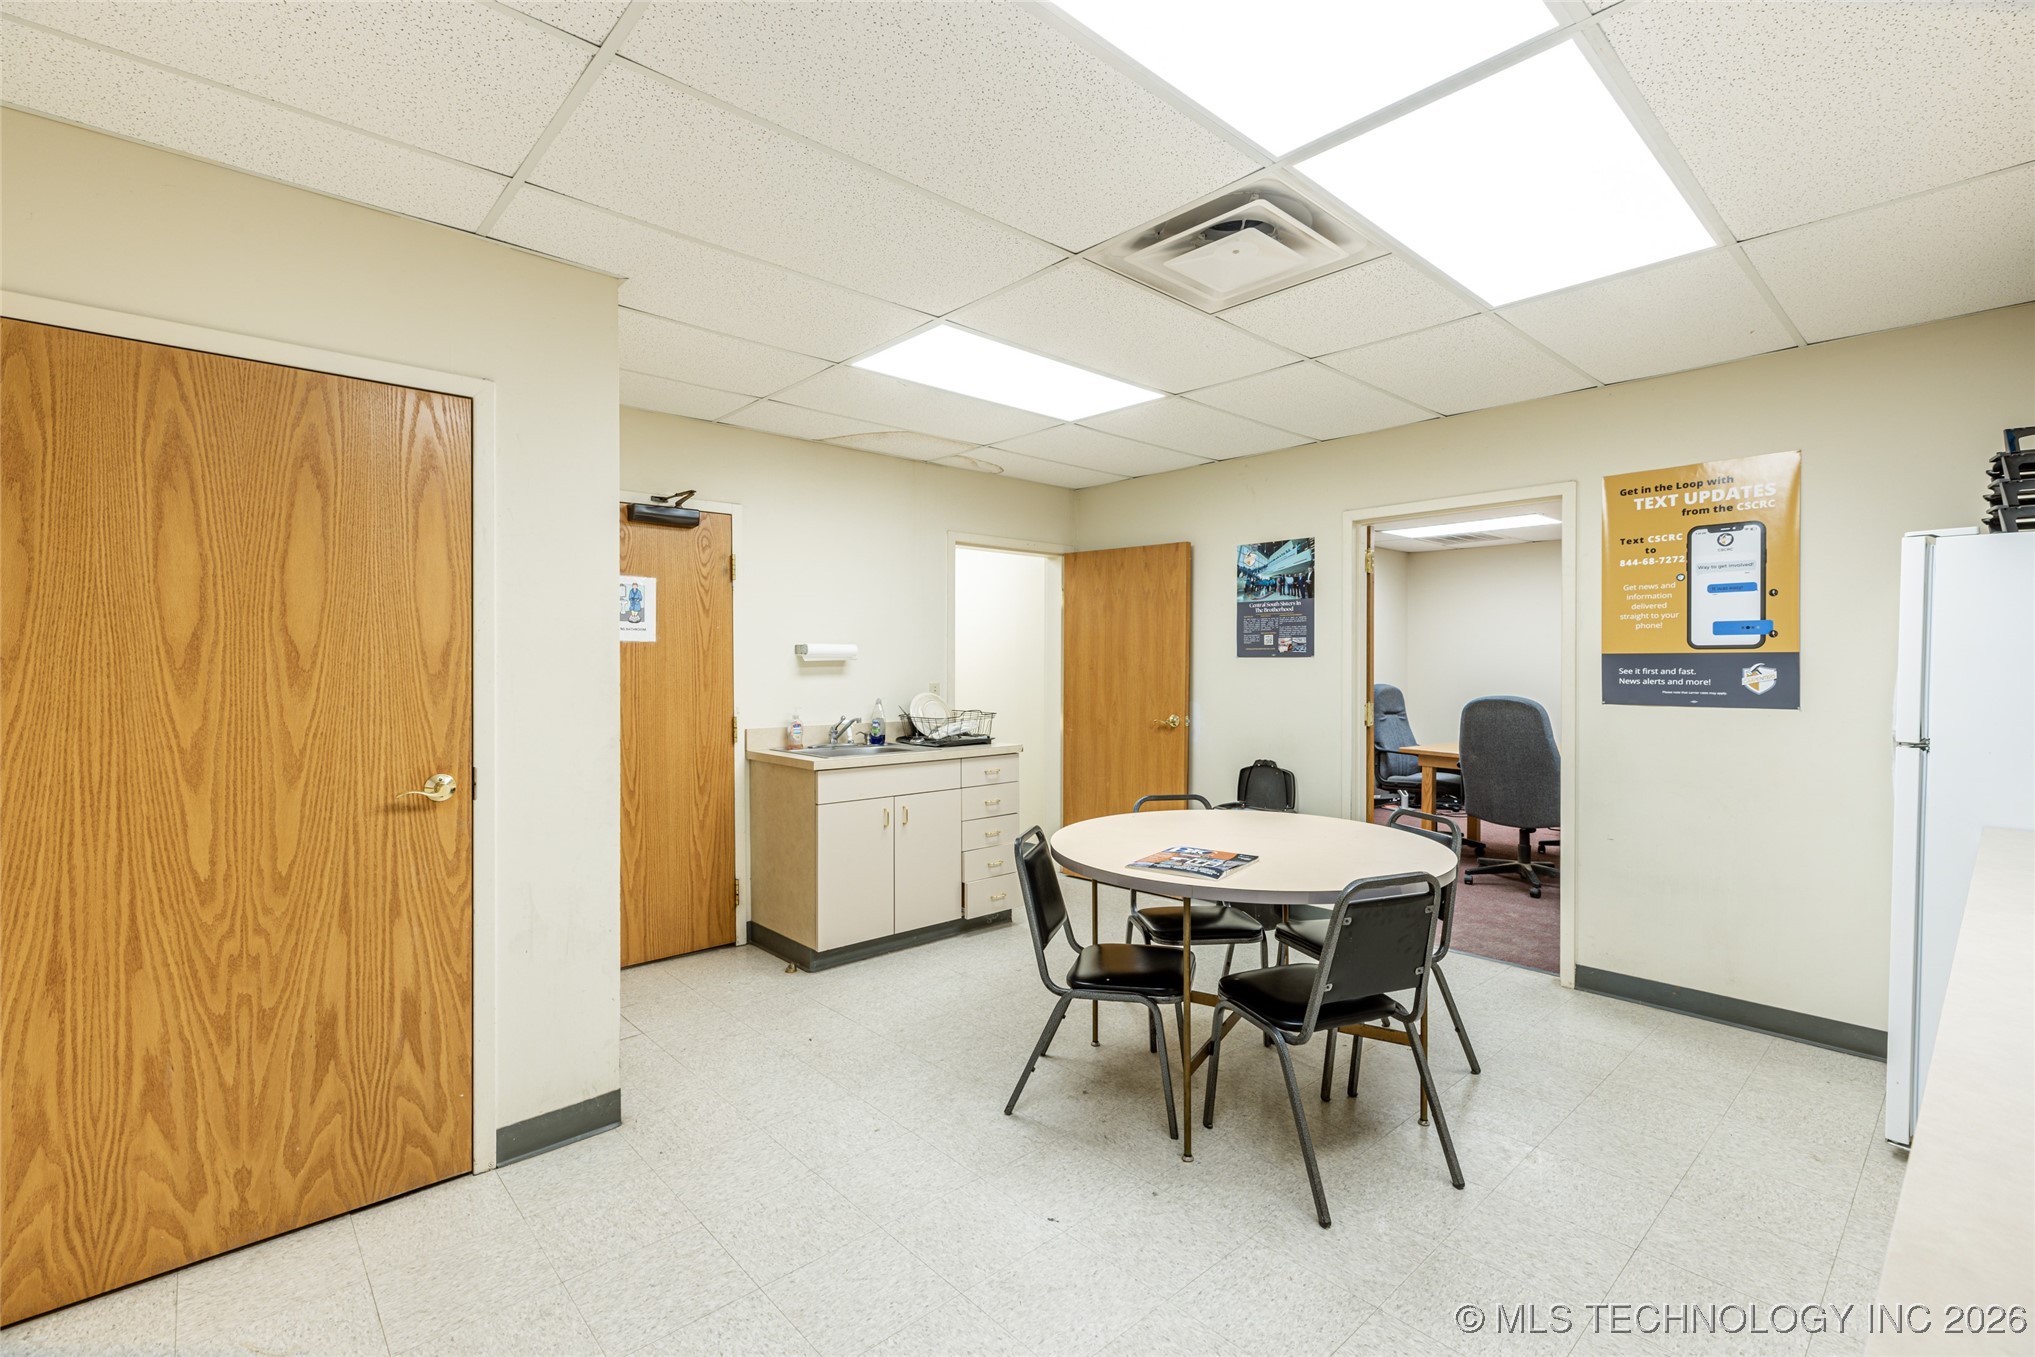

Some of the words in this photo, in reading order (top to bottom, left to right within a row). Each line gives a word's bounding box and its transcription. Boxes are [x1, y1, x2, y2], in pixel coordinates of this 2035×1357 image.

[1620, 488, 1639, 497] Get
[1641, 486, 1651, 494] in
[1654, 484, 1673, 492] the
[1676, 480, 1703, 490] Loop
[1707, 476, 1734, 486] with
[1634, 494, 1679, 511] TEXT
[1684, 483, 1776, 505] UPDATES
[1682, 507, 1710, 516] from
[1713, 504, 1733, 513] the
[1737, 499, 1776, 511] CSCRC
[1620, 537, 1644, 545] Text
[1648, 533, 1683, 543] CSCRC
[1645, 546, 1656, 554] to
[1627, 593, 1672, 601] information
[1631, 602, 1667, 610] delivered
[1620, 613, 1649, 621] straight
[1661, 612, 1679, 621] your
[1635, 622, 1663, 630] phone!
[1685, 678, 1711, 686] more!
